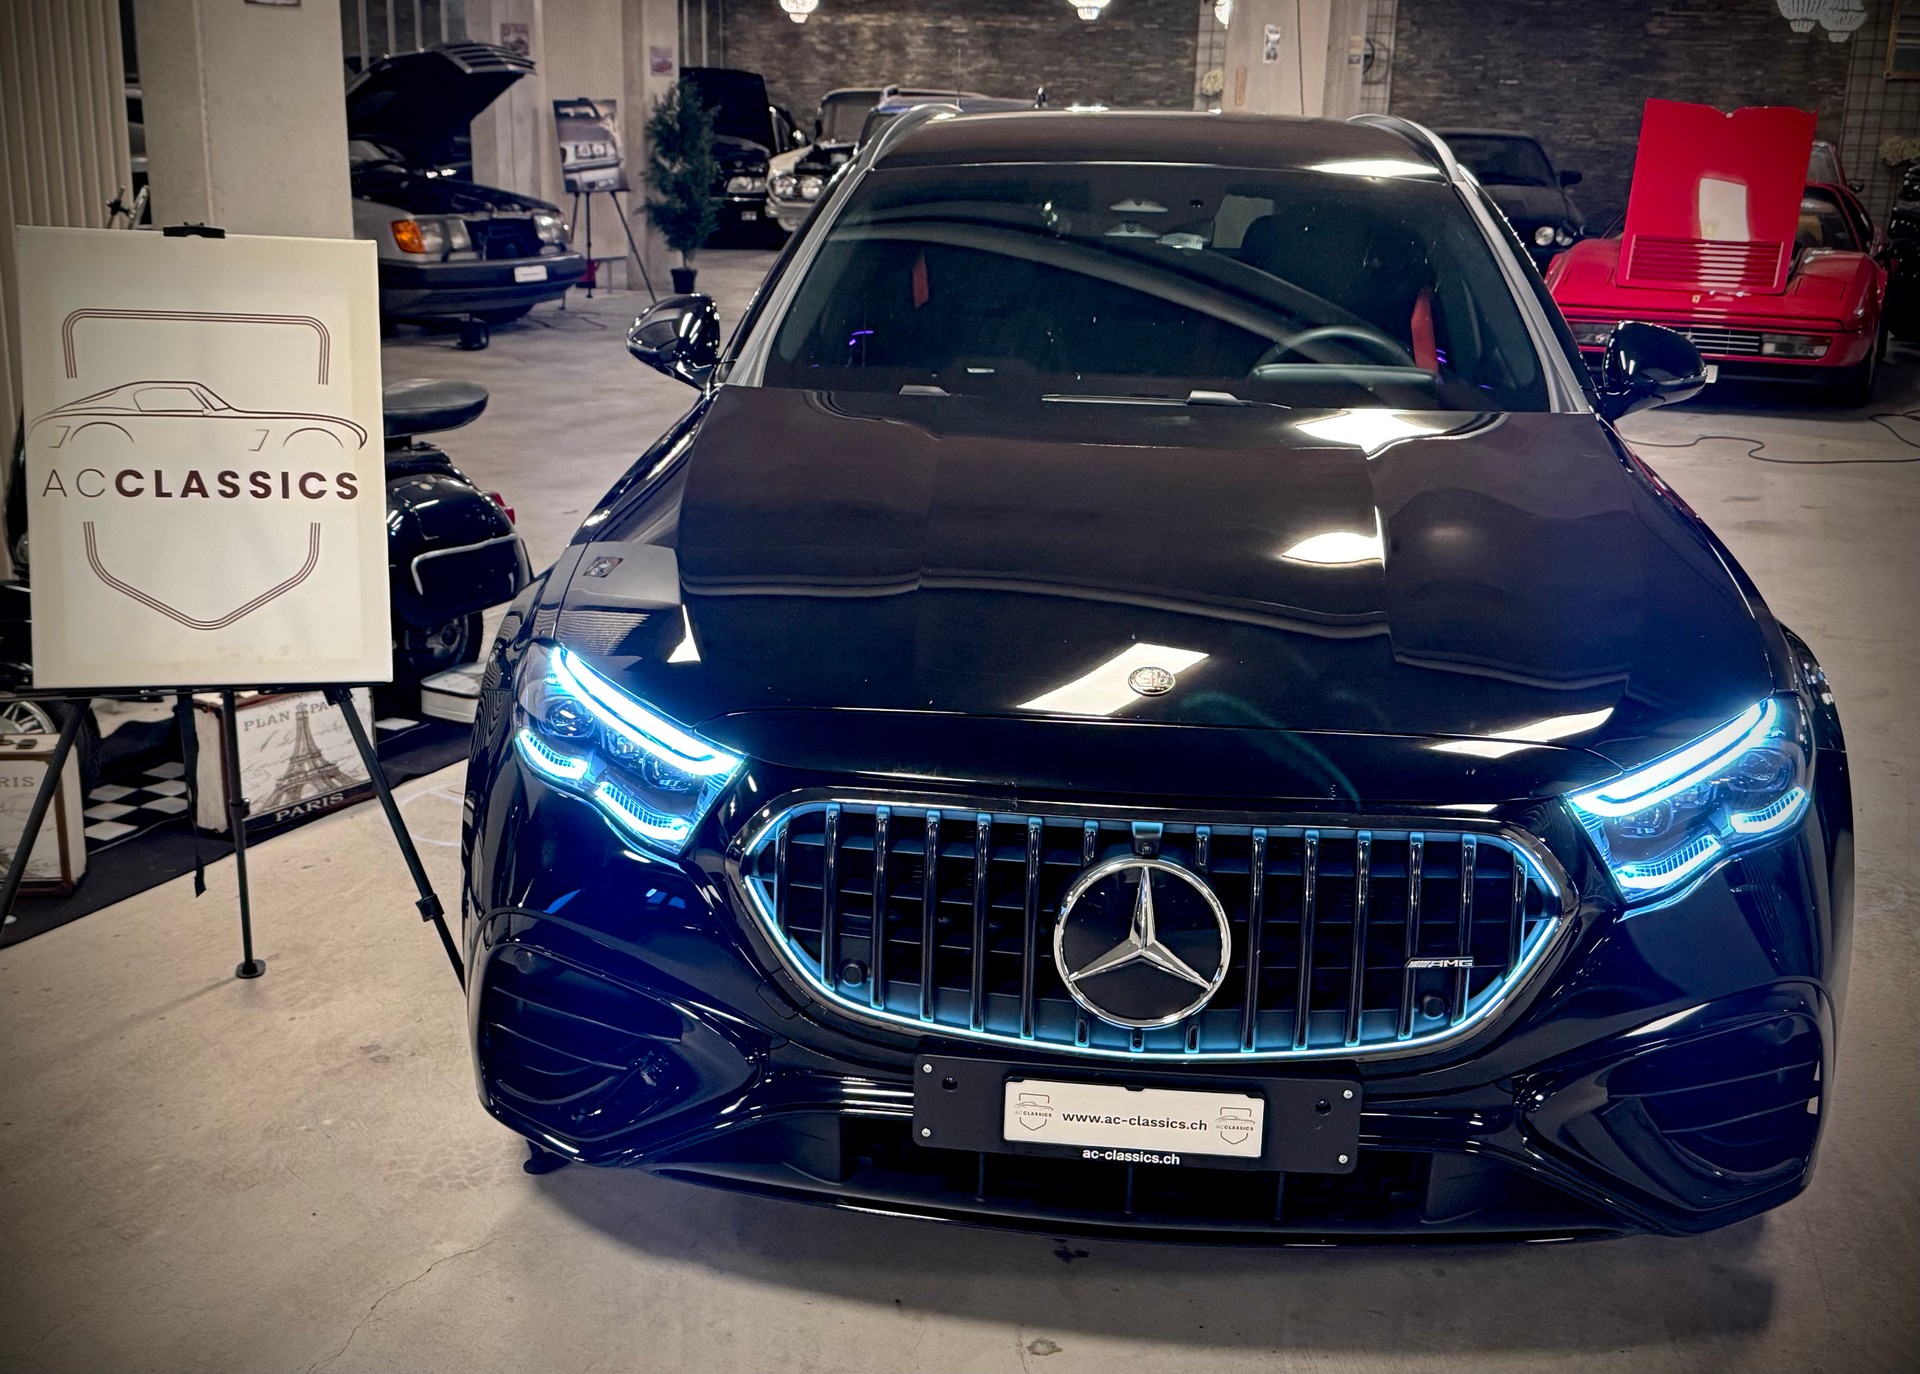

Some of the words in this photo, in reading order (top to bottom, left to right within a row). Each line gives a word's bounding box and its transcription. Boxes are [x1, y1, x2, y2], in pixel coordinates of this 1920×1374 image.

[243, 710, 290, 732] PLAN
[275, 793, 344, 822] PARIS
[1062, 1113, 1207, 1131] www.ac-classics.ch
[1082, 1149, 1180, 1165] ac-classics.ch
